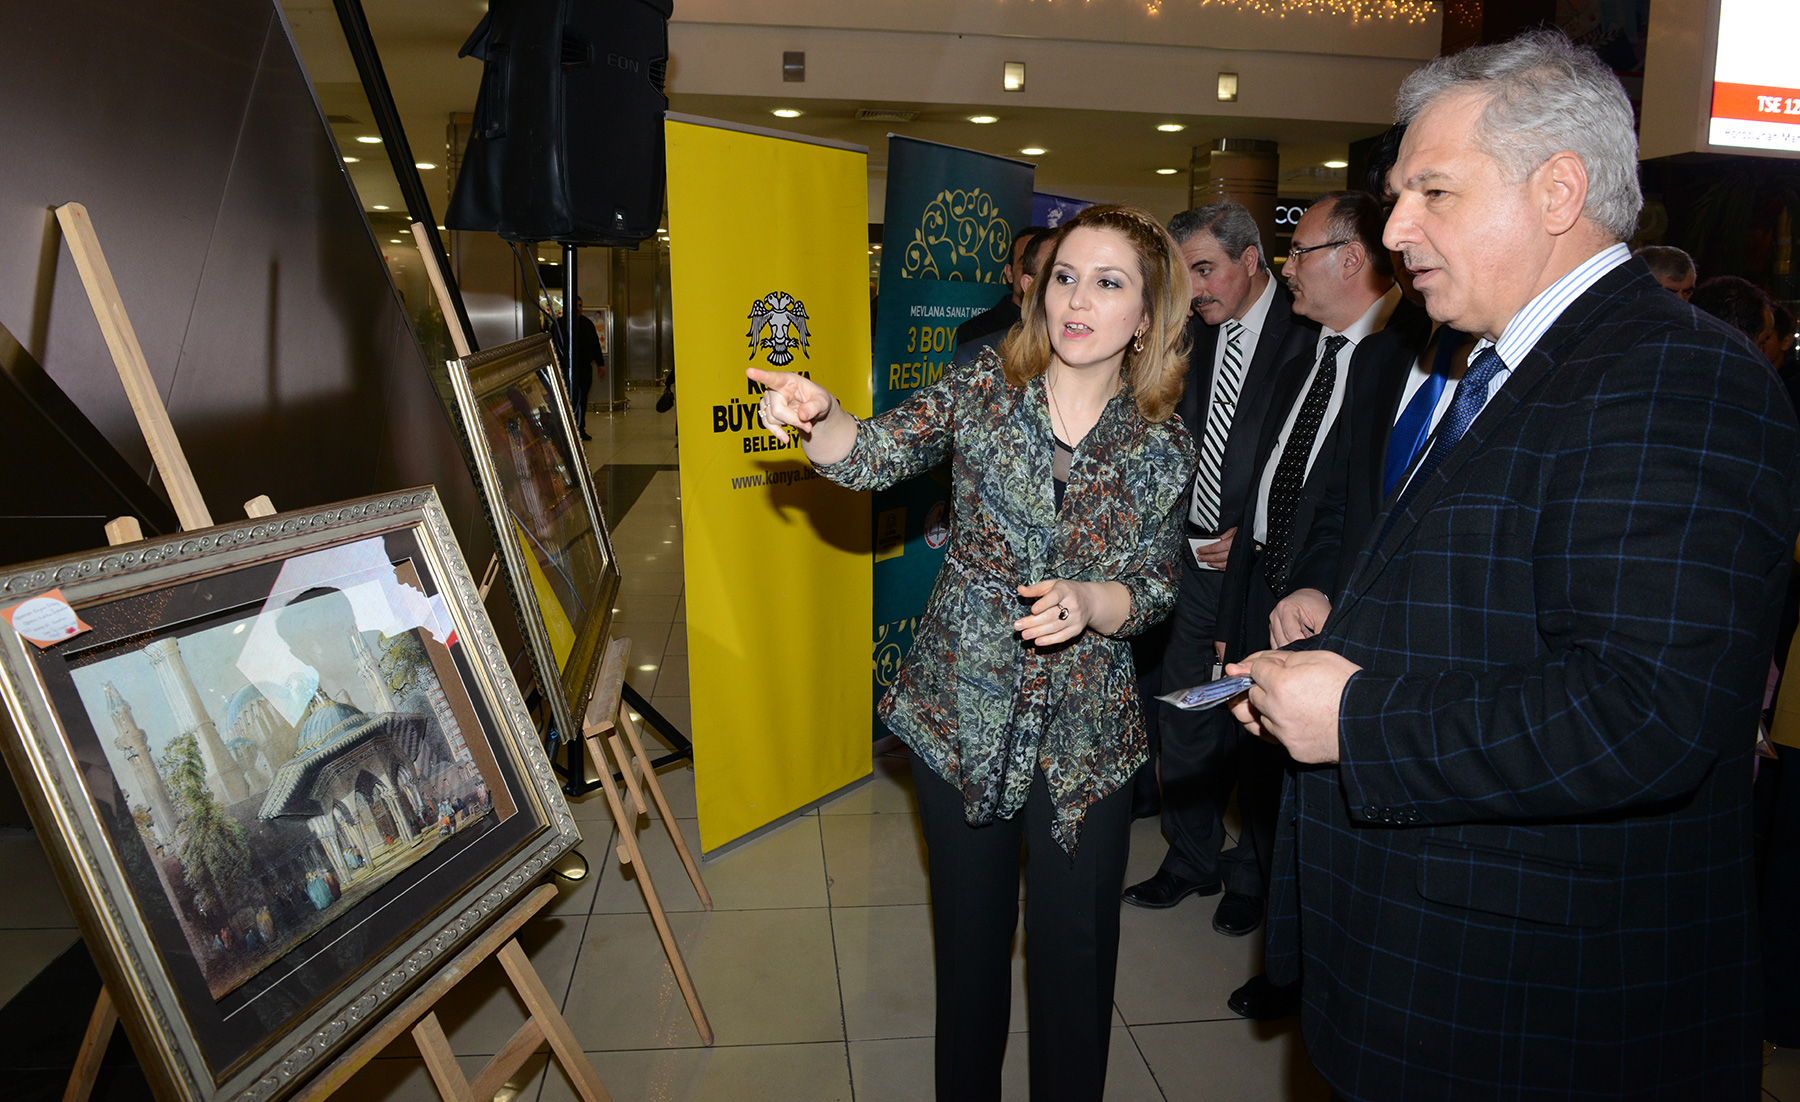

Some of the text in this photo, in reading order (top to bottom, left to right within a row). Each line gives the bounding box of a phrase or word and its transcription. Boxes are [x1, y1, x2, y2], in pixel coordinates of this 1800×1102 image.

[607, 53, 639, 74] EON
[1757, 95, 1783, 113] TSE
[1275, 206, 1308, 225] CO
[910, 305, 945, 317] MEVLANA
[946, 306, 971, 318] SANAT
[907, 326, 917, 353] 3
[889, 355, 944, 391] RESİM
[743, 430, 802, 453] BELEDİY
